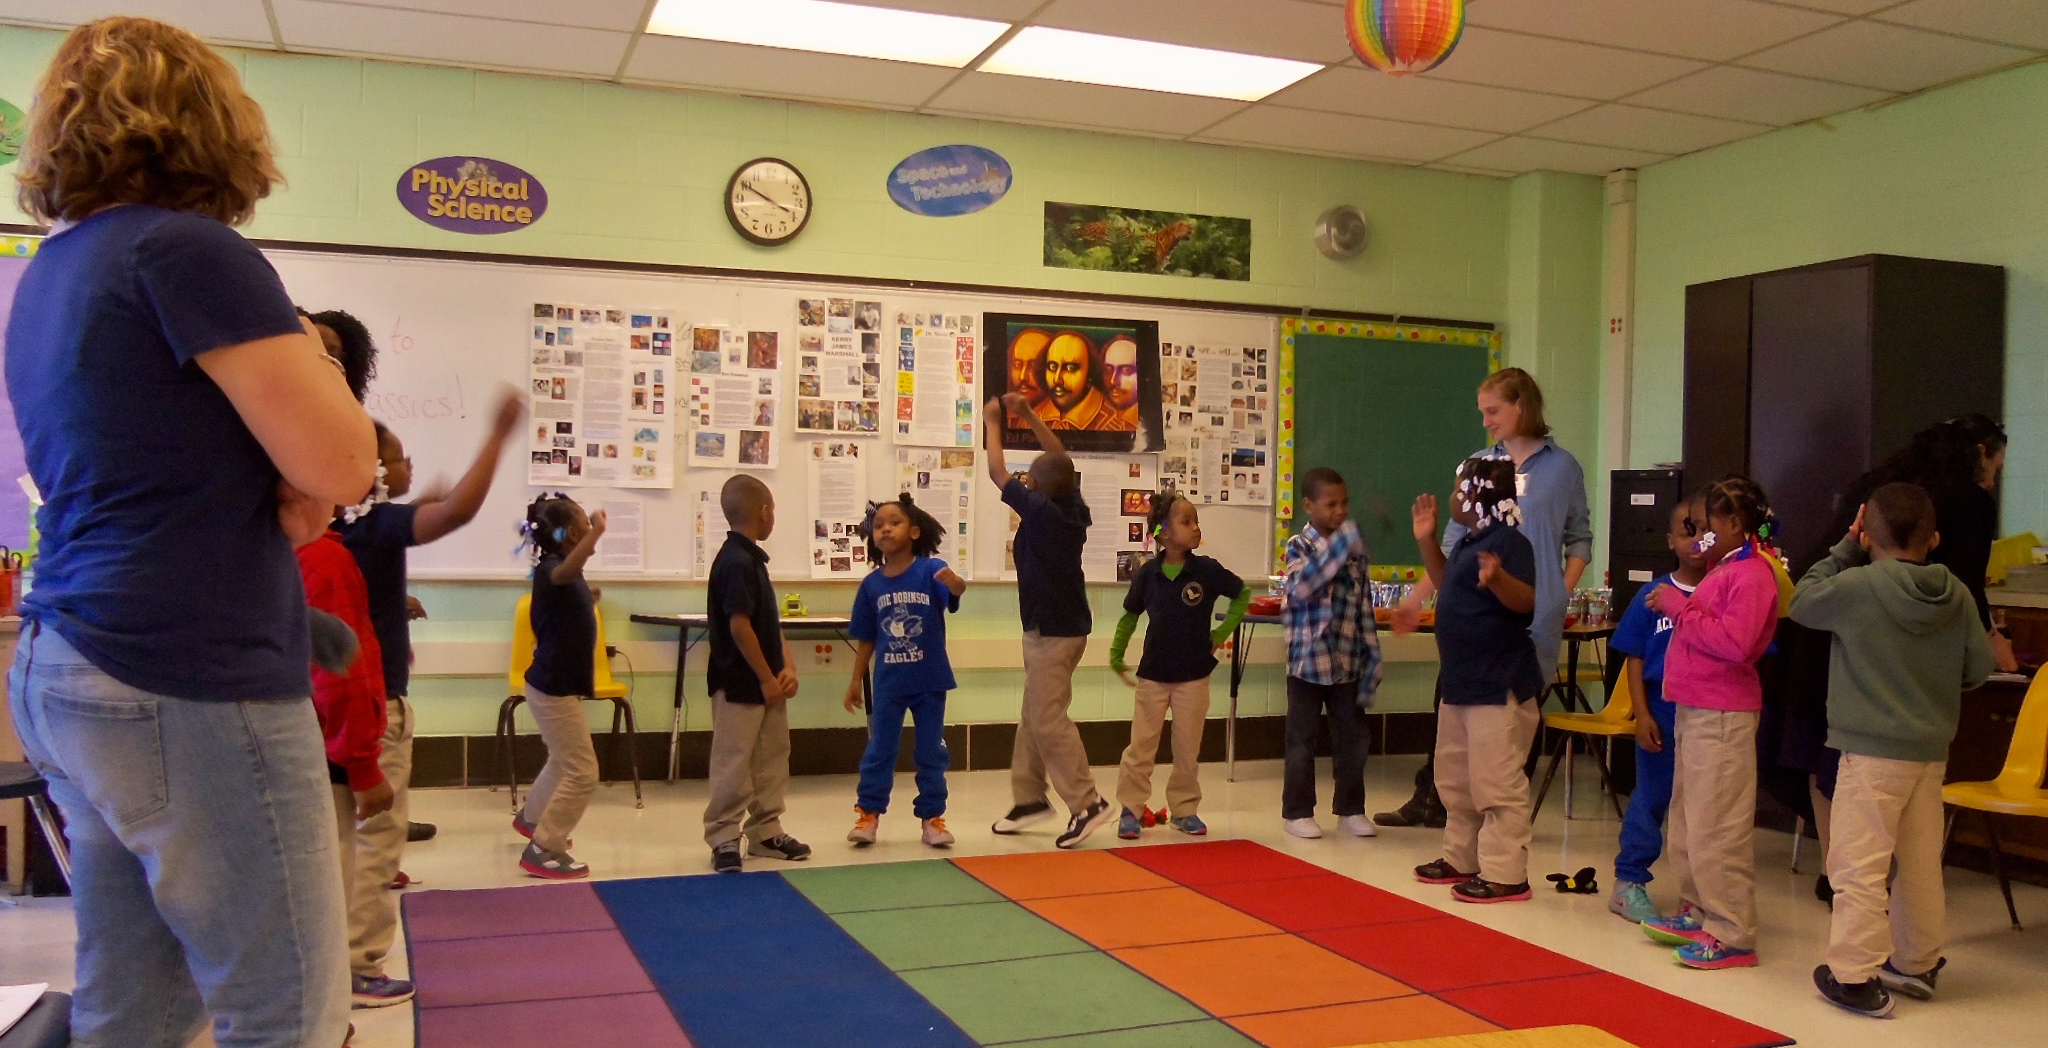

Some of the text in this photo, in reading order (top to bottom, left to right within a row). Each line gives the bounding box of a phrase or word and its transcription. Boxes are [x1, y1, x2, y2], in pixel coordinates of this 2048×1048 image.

[411, 168, 529, 201] Physical
[897, 168, 949, 184] Space
[911, 178, 1007, 201] Technology
[427, 193, 533, 224] Science
[764, 223, 773, 236] 6
[389, 316, 414, 355] to
[368, 373, 466, 421] assics!
[893, 592, 930, 605] ROBINSON
[885, 650, 924, 663] EAGLES
